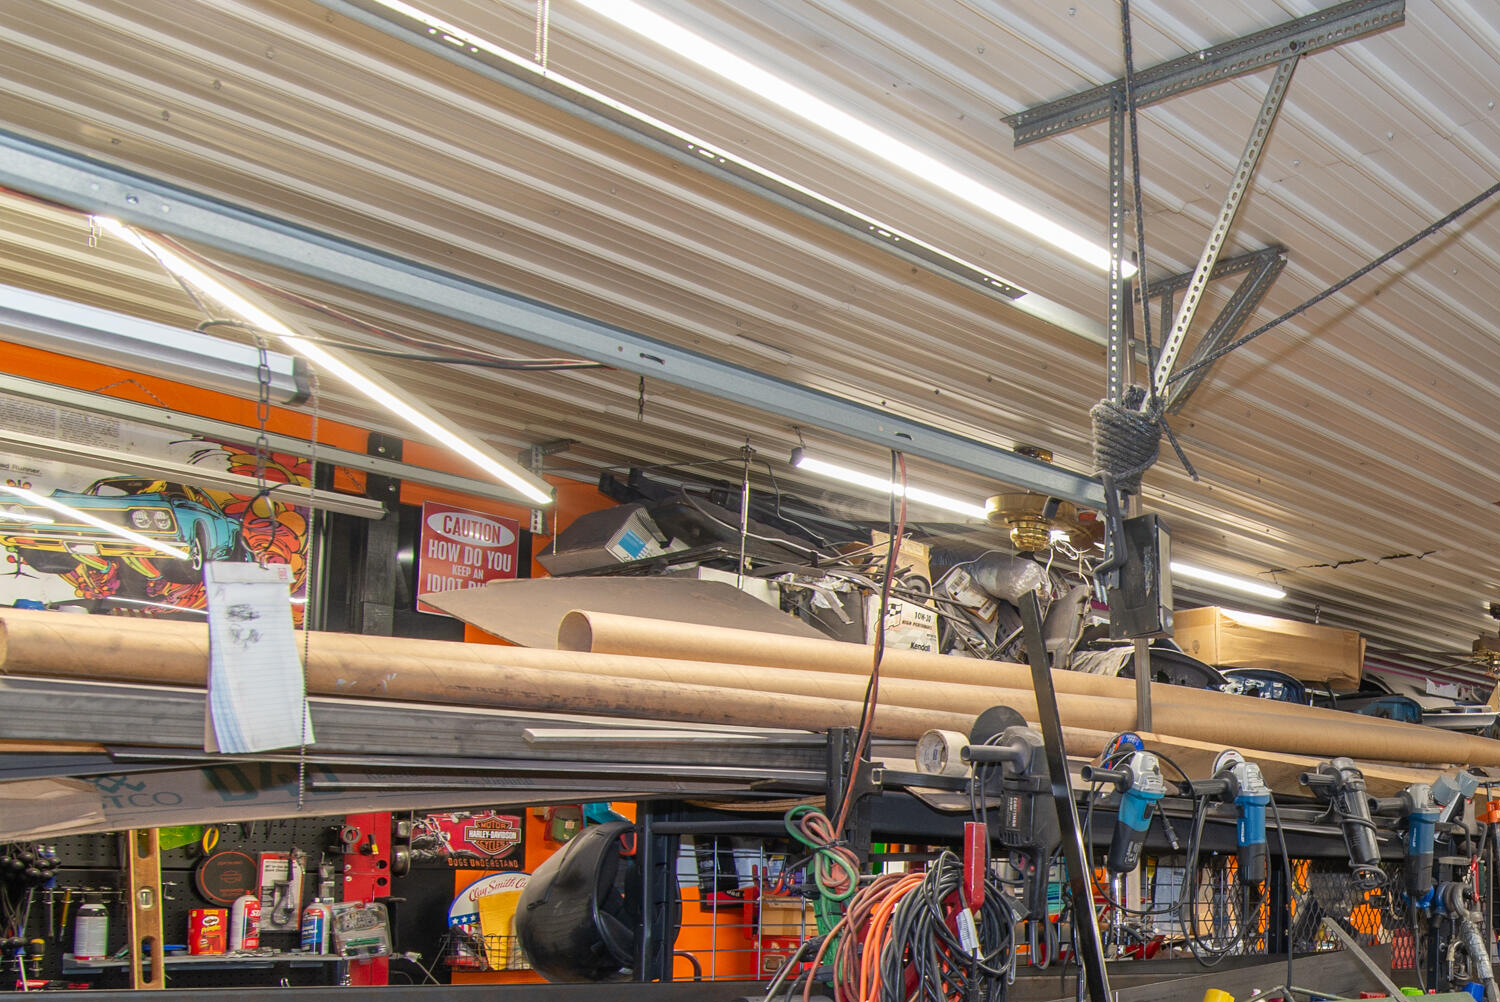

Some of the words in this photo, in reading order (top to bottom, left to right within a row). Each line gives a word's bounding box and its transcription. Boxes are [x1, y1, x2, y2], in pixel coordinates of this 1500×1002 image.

[443, 515, 501, 544] CAUTION
[428, 539, 460, 563] HOW
[464, 547, 482, 567] DO
[487, 550, 512, 572] YOU
[452, 564, 471, 577] KEEP
[473, 569, 484, 579] AN
[427, 573, 464, 593] IDIOT
[910, 641, 931, 652] Kendall
[469, 829, 517, 840] HARLEY-DAVIDSON
[469, 887, 488, 902] Clay
[488, 878, 515, 893] Smith
